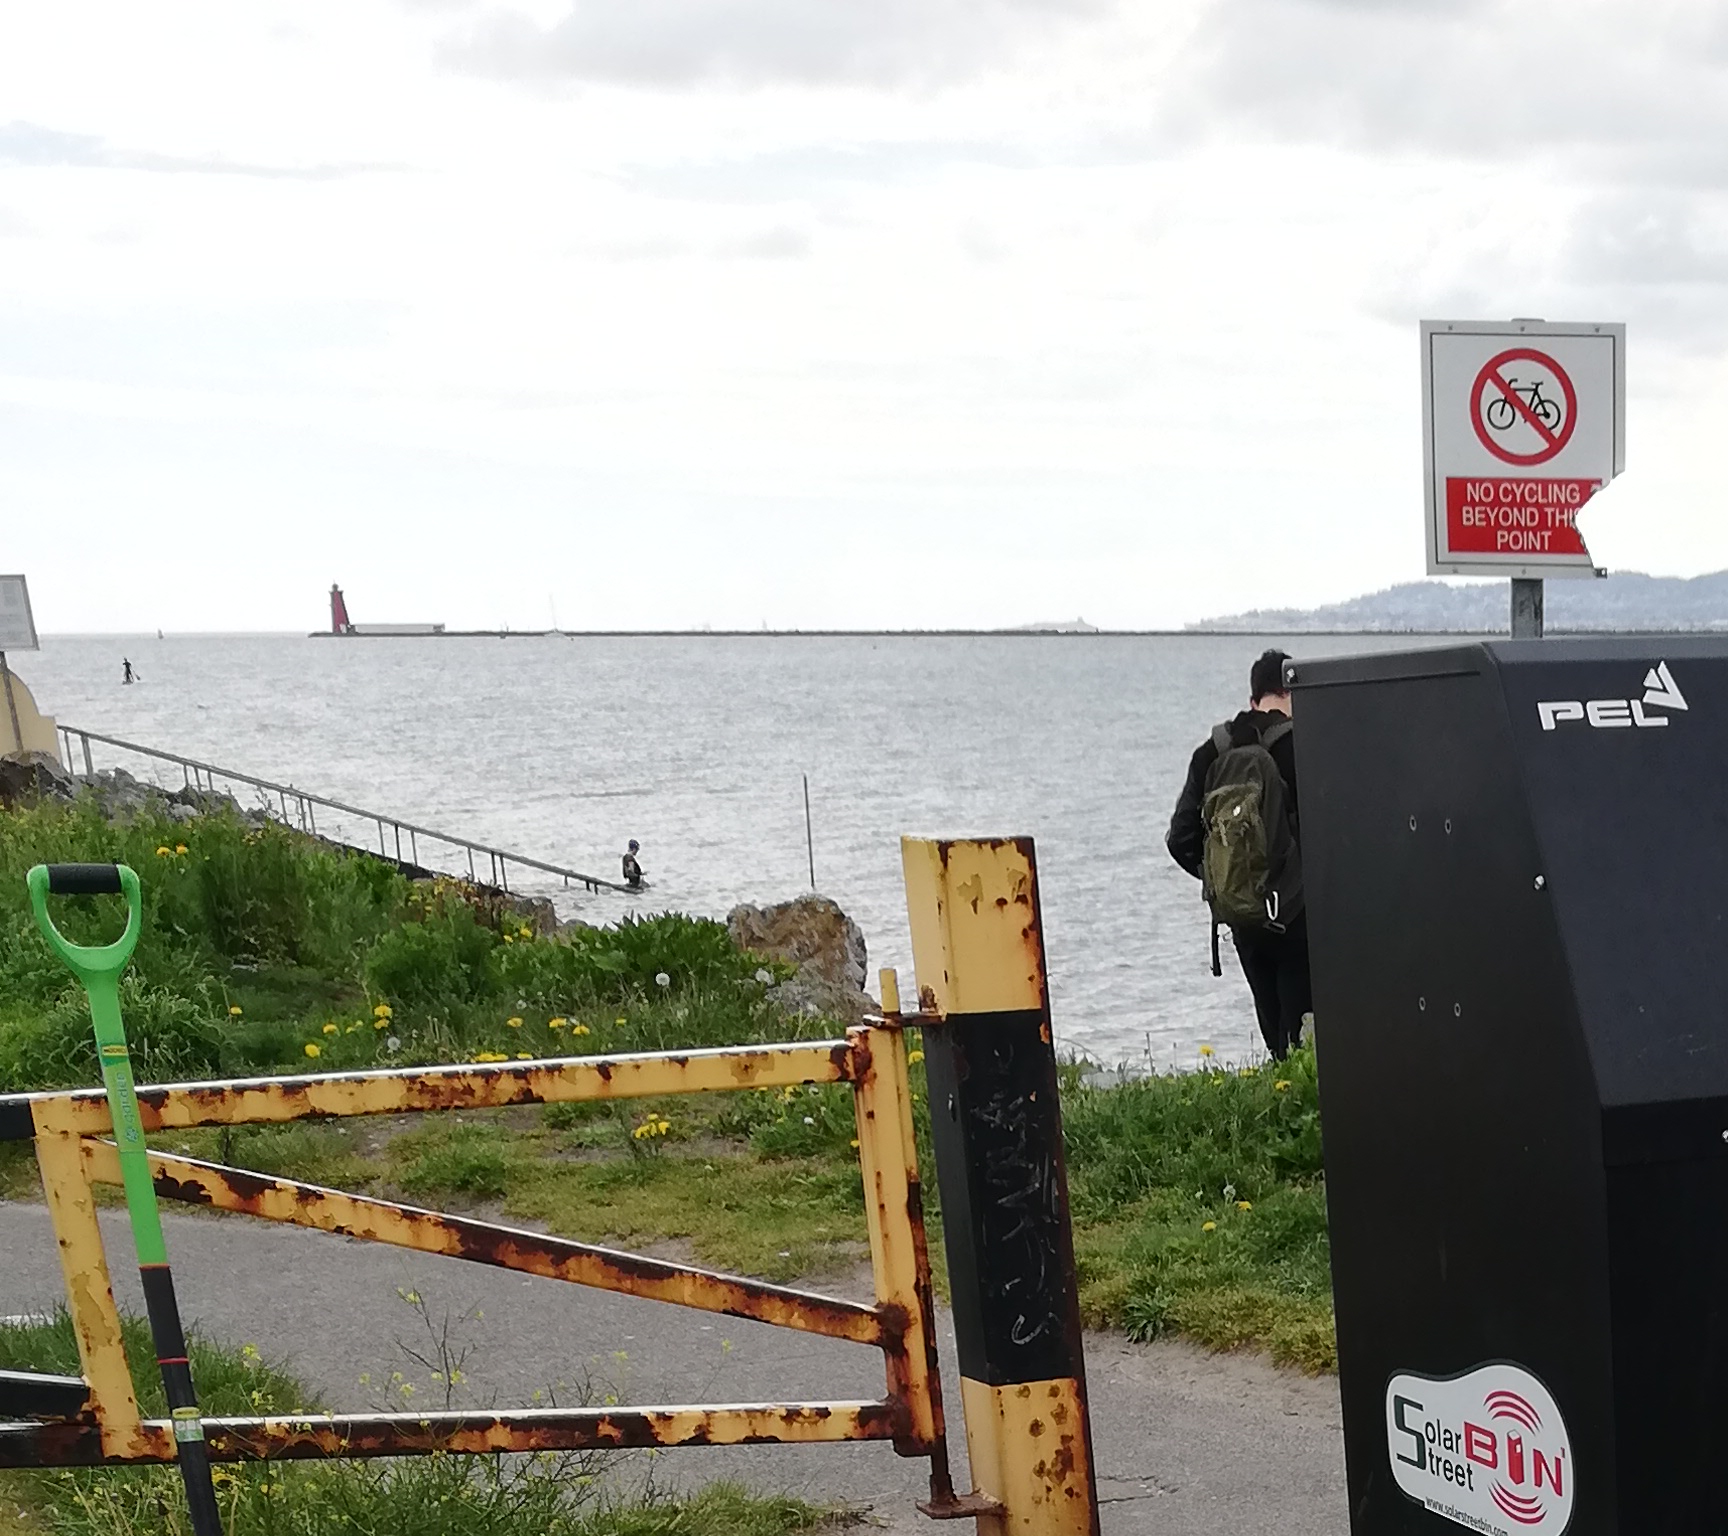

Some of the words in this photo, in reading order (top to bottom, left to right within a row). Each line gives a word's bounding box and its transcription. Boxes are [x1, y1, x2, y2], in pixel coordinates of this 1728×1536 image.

[1466, 482, 1494, 503] NO
[1500, 482, 1581, 504] CYCLING
[1462, 505, 1539, 527] BEYOND
[1496, 530, 1552, 551] POINT
